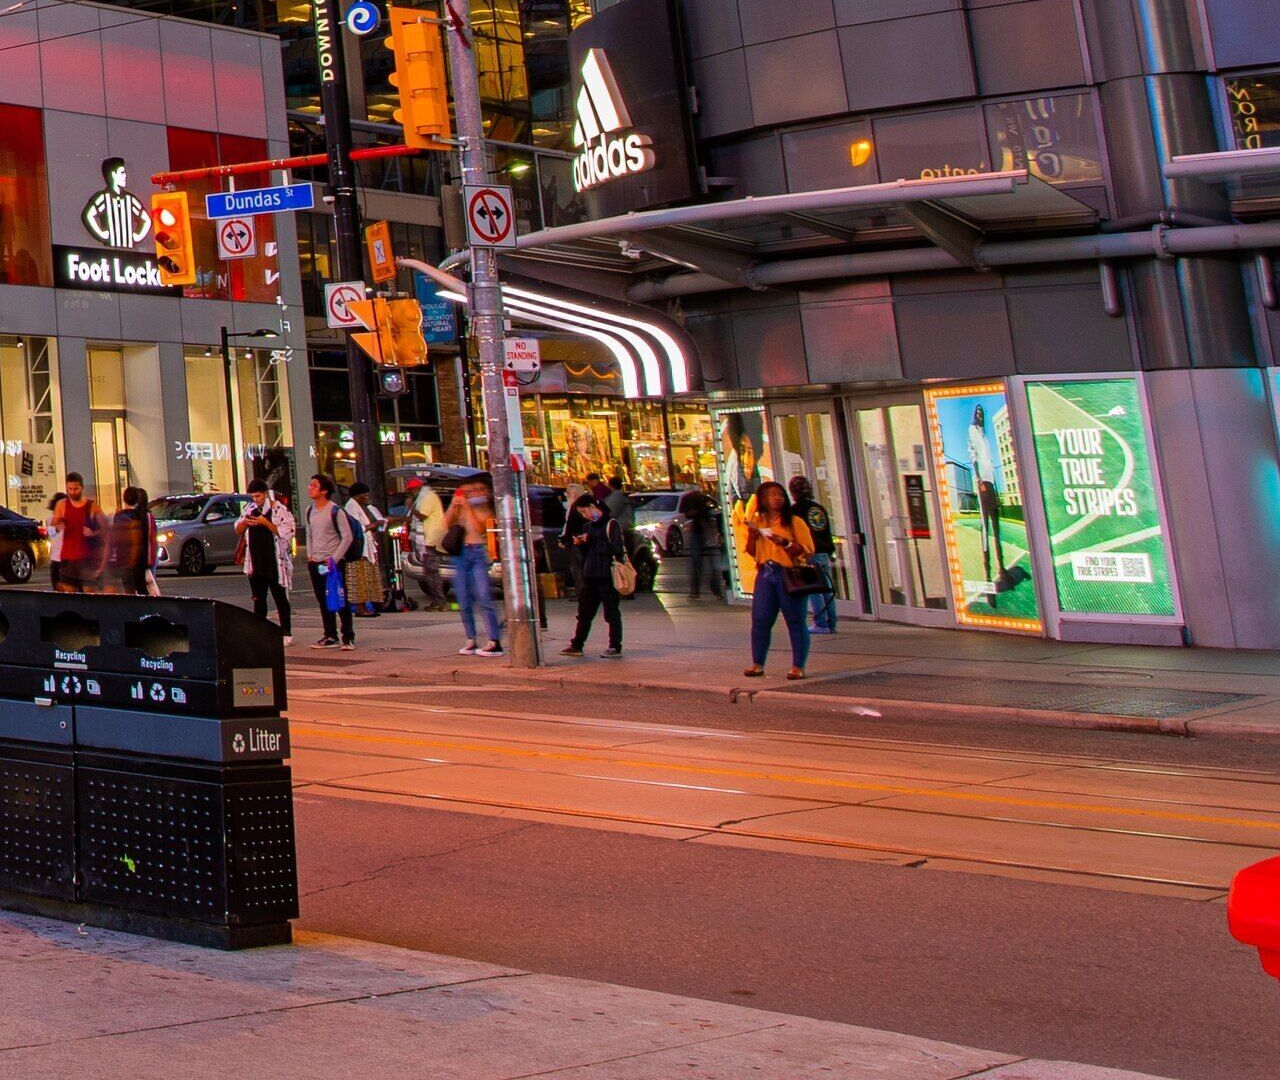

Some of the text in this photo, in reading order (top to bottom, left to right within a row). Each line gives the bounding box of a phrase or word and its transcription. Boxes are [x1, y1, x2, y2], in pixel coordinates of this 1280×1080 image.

[574, 130, 646, 192] adidas
[225, 188, 294, 211] Dundas St
[67, 254, 173, 287] Foot Lock
[506, 351, 538, 360] STANDING
[515, 342, 526, 350] NO
[1054, 429, 1104, 455] YOUR
[1058, 458, 1106, 485] TRUE
[1063, 488, 1138, 516] STRIPES
[1077, 567, 1119, 577] TRUE STRIPES
[1085, 557, 1117, 566] FIND YOUR
[55, 650, 86, 663] Recycling
[140, 657, 174, 671] Recycling
[249, 728, 281, 752] Litter
